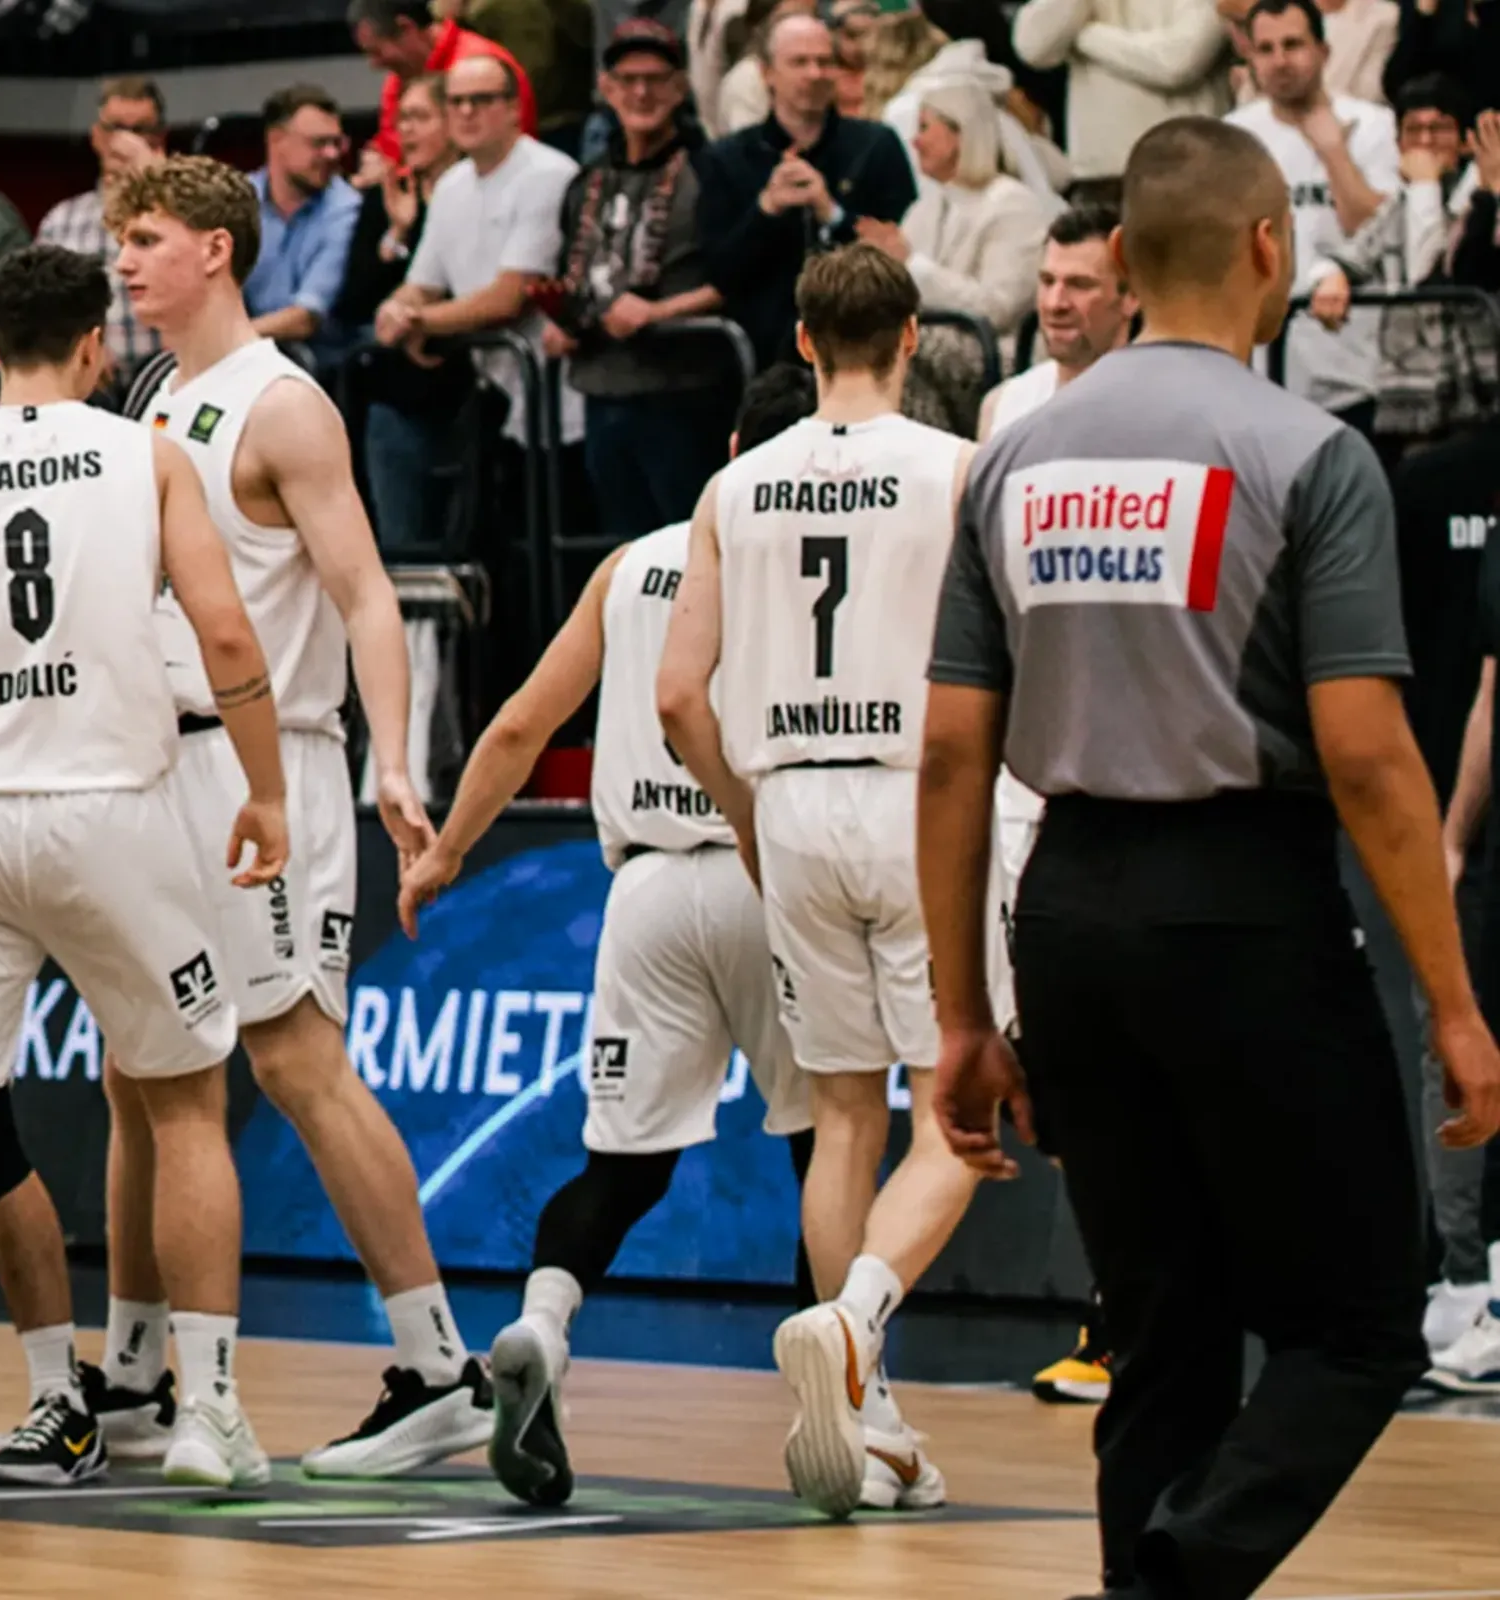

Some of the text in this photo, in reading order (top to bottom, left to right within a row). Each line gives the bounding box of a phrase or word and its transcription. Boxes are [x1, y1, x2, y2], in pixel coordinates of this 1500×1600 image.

[753, 476, 900, 514] DRAGONS
[1022, 477, 1175, 547] junited
[3, 507, 55, 645] 8
[801, 536, 848, 678] 7
[632, 779, 724, 817] ANTHO
